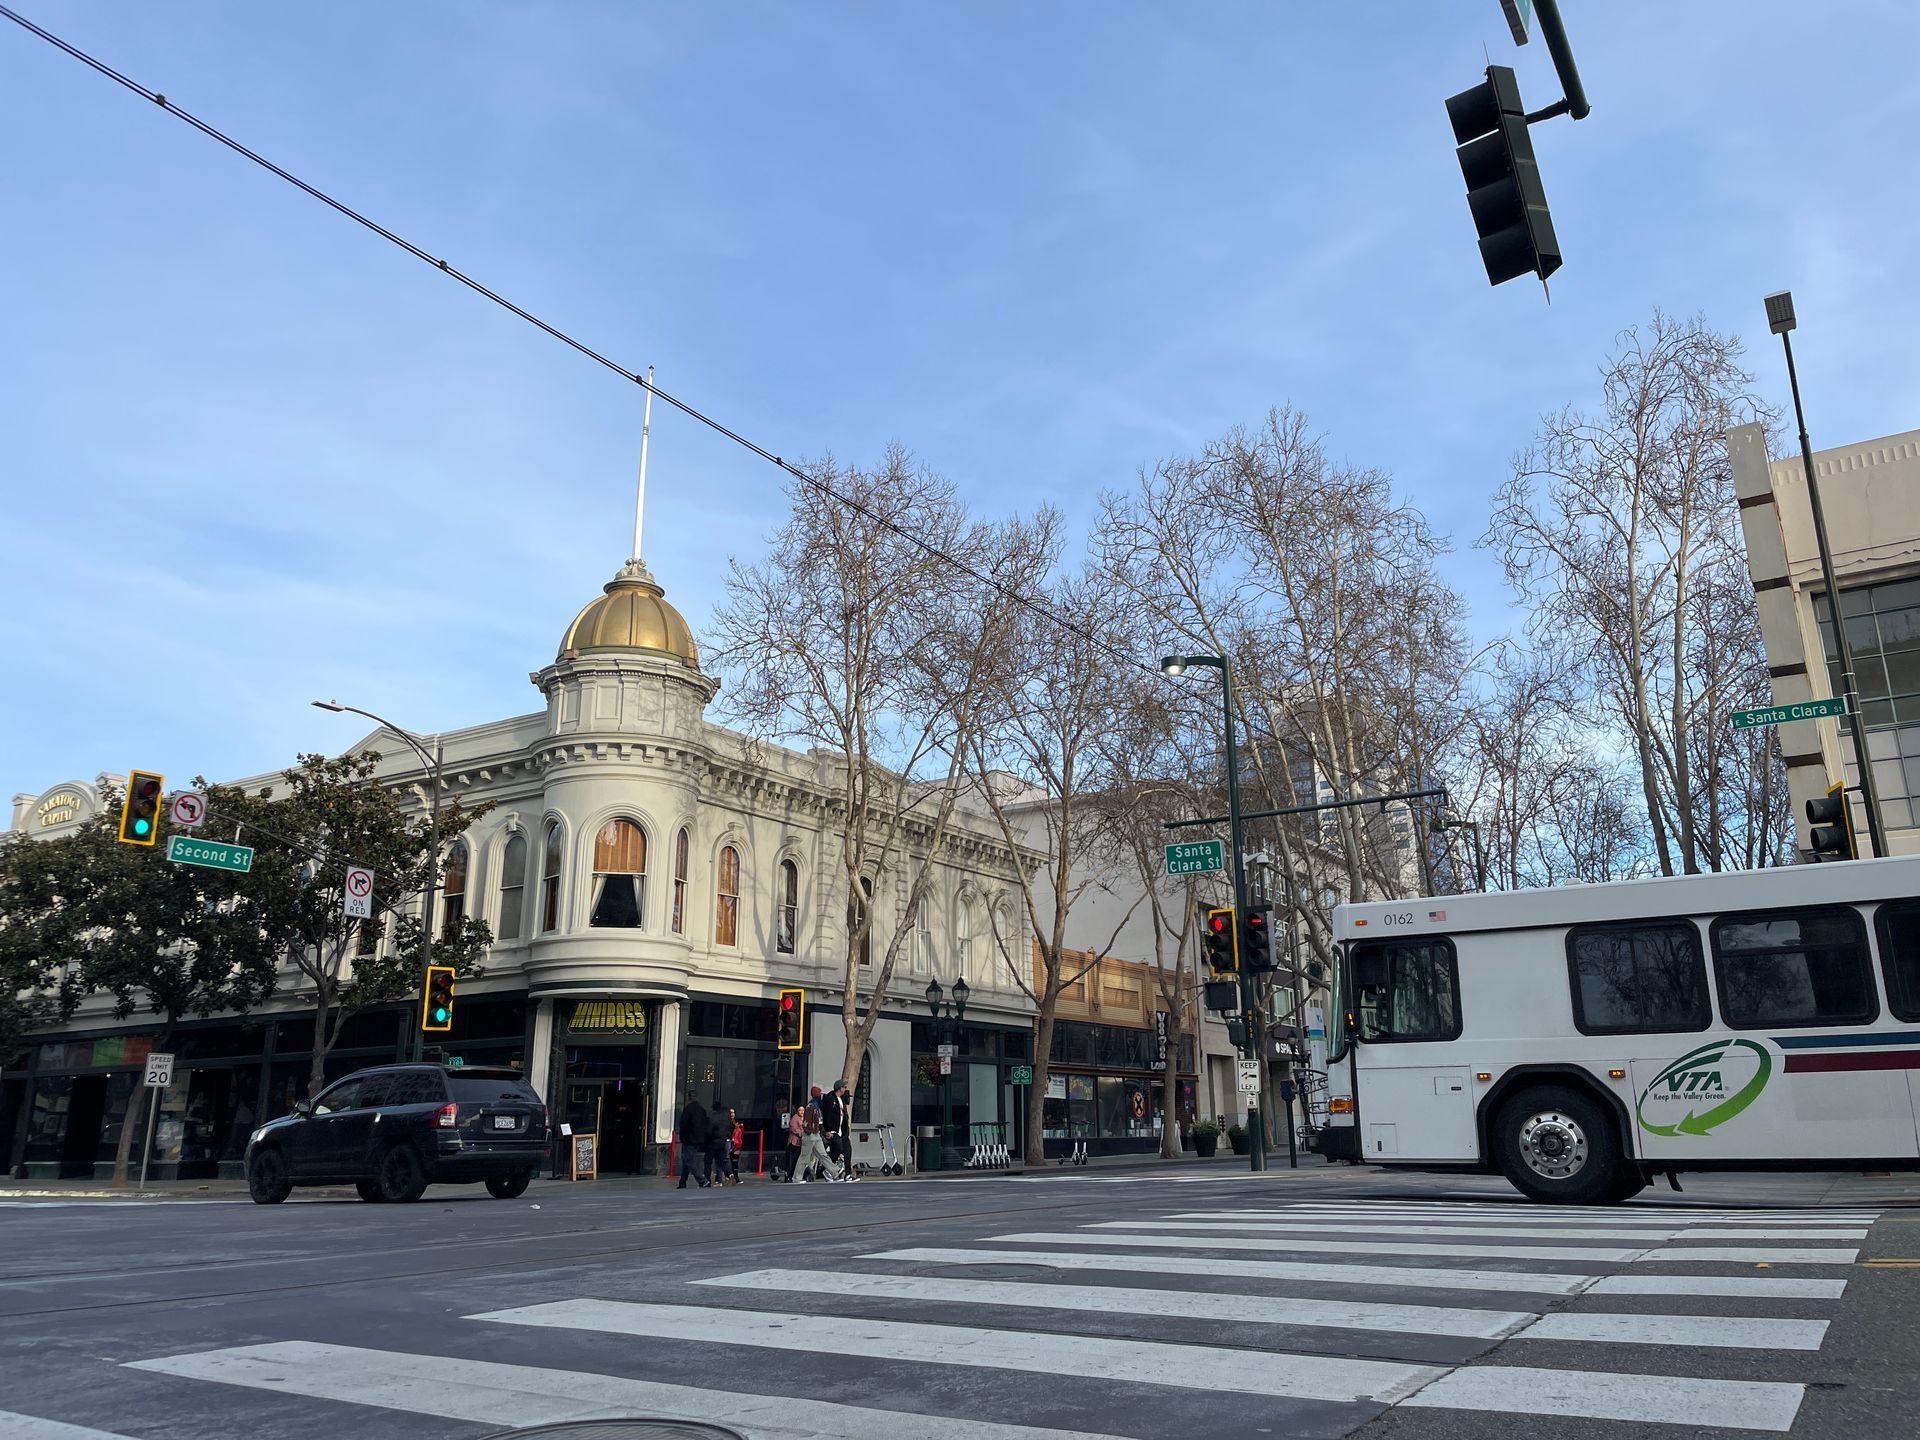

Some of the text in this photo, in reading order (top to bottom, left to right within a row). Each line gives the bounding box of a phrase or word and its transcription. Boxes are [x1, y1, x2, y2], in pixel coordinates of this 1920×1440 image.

[1746, 710, 1786, 725] Santa
[1791, 705, 1827, 718] Clara
[1833, 705, 1842, 713] St
[38, 794, 80, 819] SARATOGA
[41, 809, 73, 827] CAPITAL
[174, 842, 249, 866] Second St
[1175, 844, 1212, 858] Santa
[1169, 856, 1221, 873] Clara St
[349, 905, 366, 915] RED
[352, 899, 364, 908] ON
[1383, 912, 1414, 926] 0162
[569, 1002, 646, 1029] MINIBOSS
[1239, 1062, 1258, 1070] KEEP
[148, 1071, 168, 1084] 20
[1667, 1071, 1723, 1092] VTA
[1653, 1092, 1727, 1102] Keep the Valley Green.
